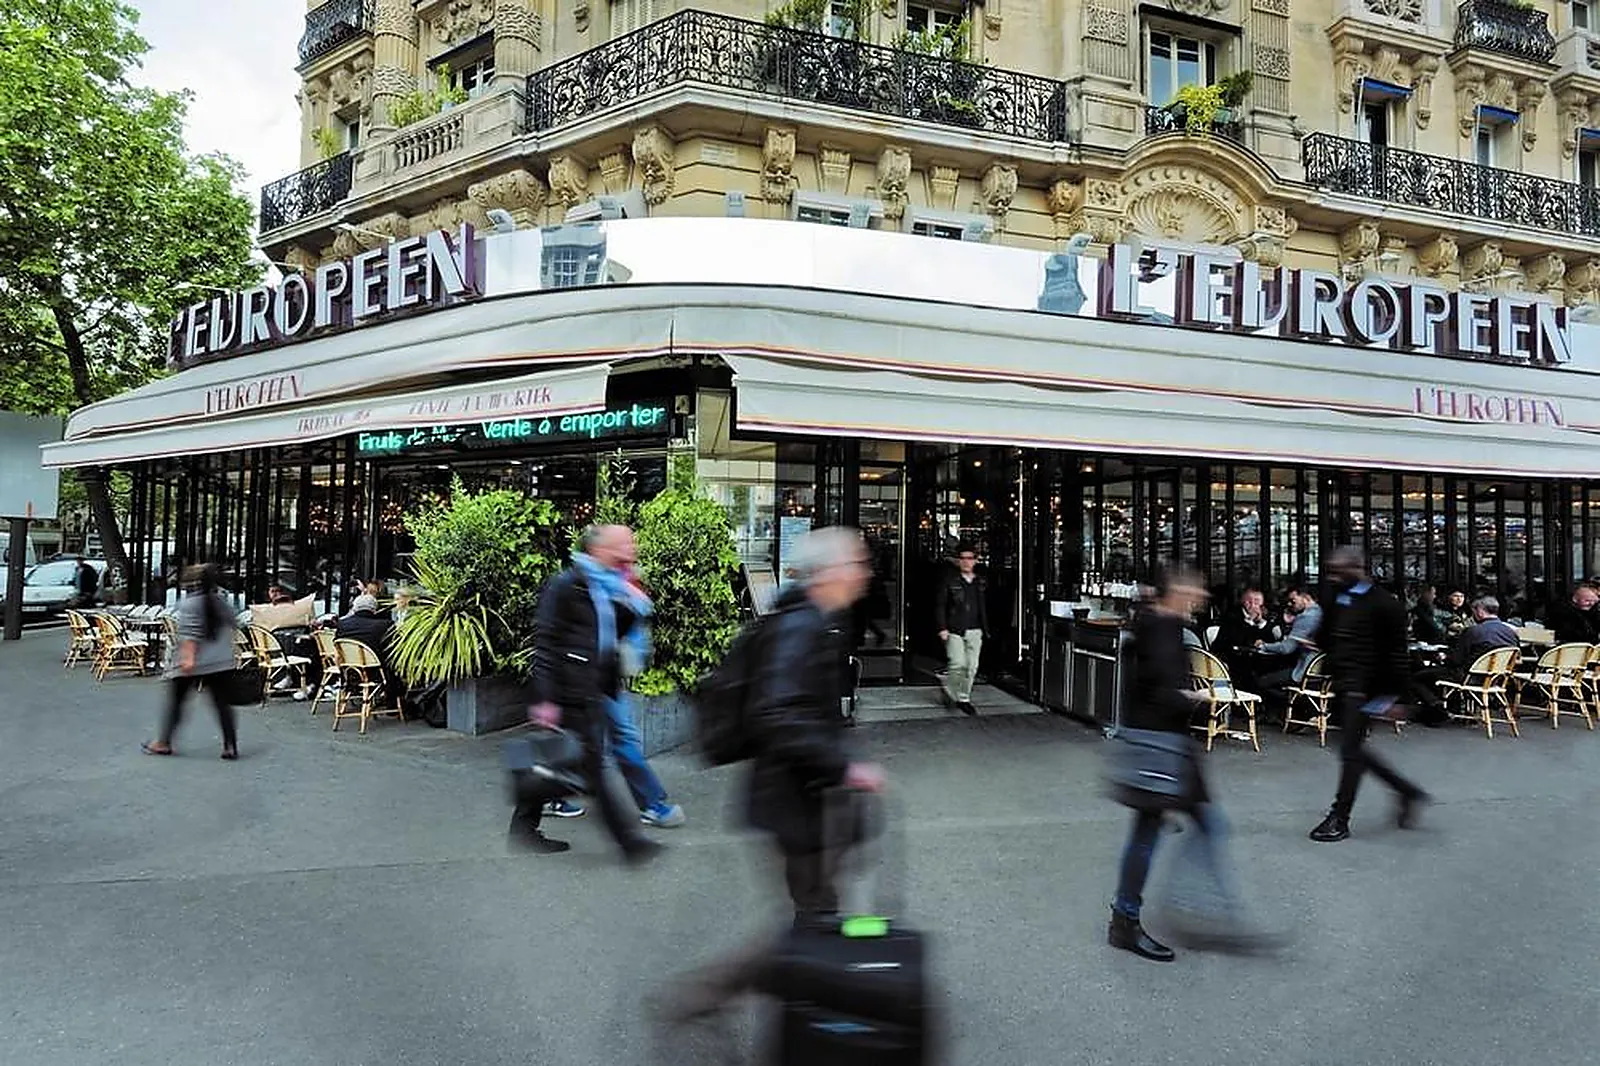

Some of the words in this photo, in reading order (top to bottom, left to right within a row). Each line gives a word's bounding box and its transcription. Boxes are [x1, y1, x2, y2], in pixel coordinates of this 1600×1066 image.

[1110, 243, 1572, 364] L'EUROPEEN
[359, 431, 402, 450] Fruits
[481, 418, 532, 440] Vente
[559, 403, 665, 439] emporter
[1414, 387, 1564, 426] L'EUROPEEN
